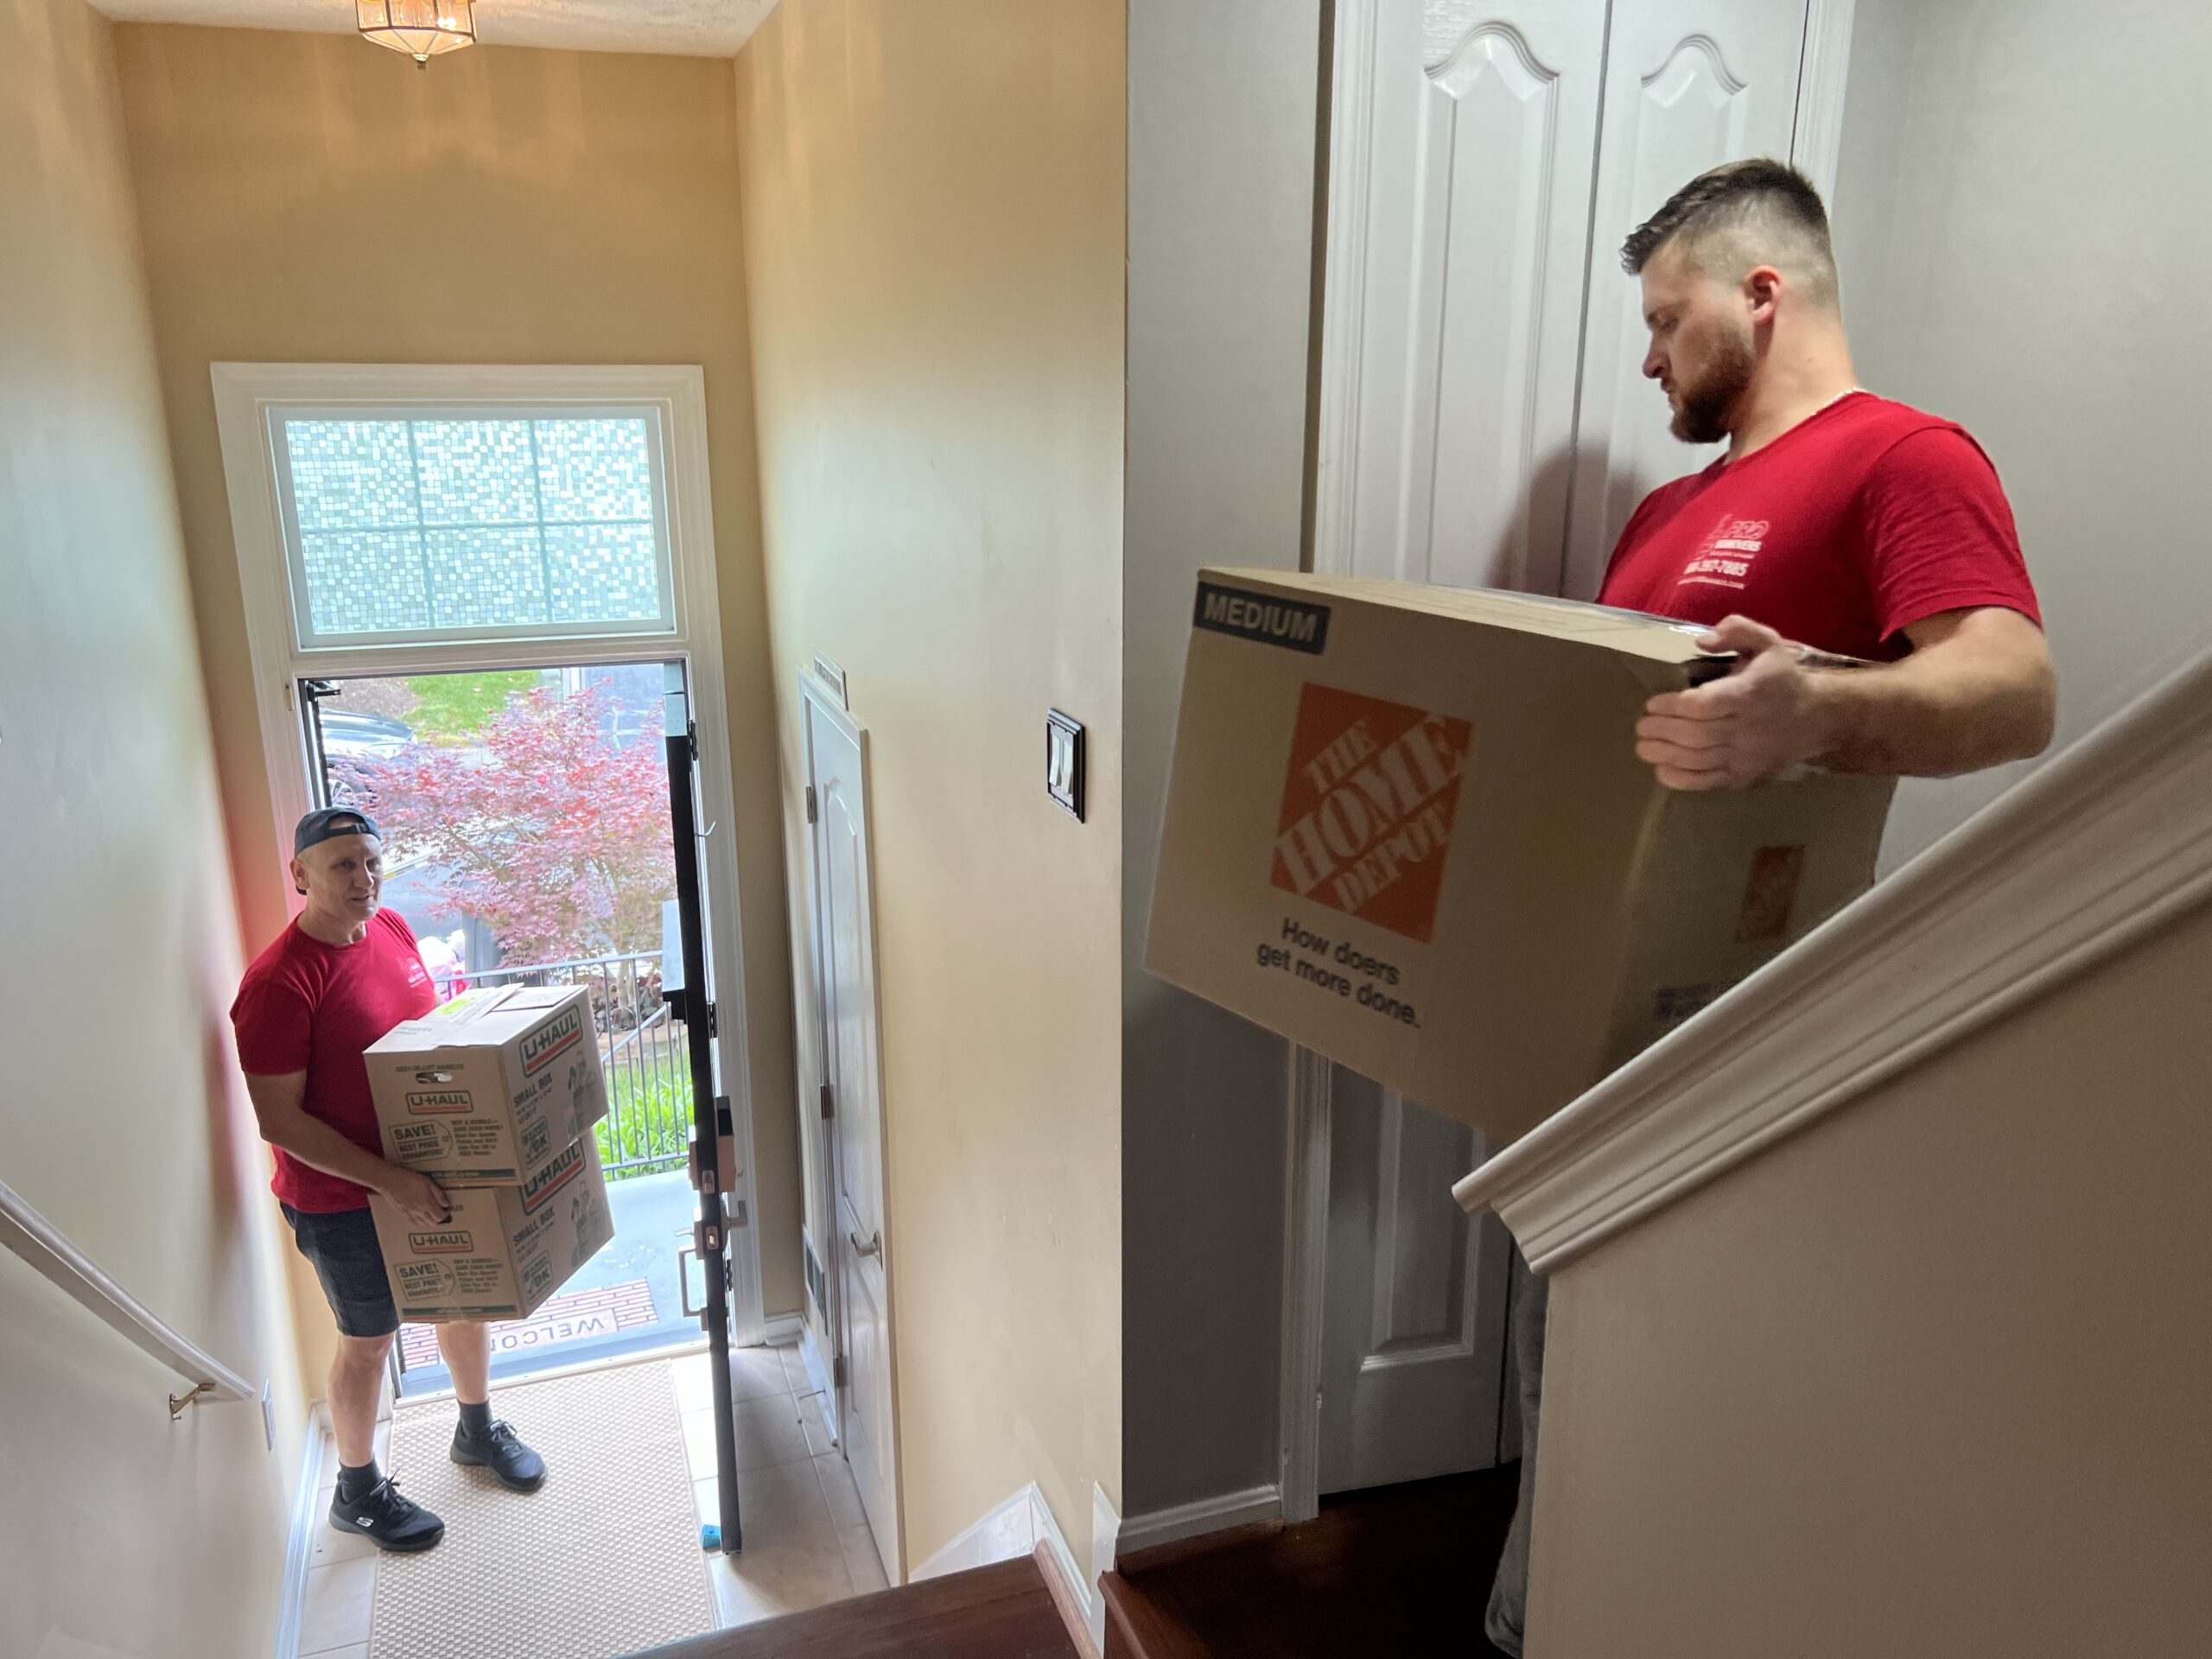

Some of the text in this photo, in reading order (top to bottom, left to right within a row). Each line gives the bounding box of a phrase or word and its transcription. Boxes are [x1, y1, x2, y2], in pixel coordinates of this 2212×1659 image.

[1204, 593, 1318, 643] MEDIUM
[1302, 717, 1380, 795] THE
[1277, 713, 1465, 899] HOME
[1332, 800, 1452, 913] DEPOT
[1281, 917, 1401, 985] How doers
[1257, 943, 1421, 1028] get more done.
[524, 1014, 577, 1060] U-HAUL
[410, 1094, 467, 1106] U-HAUL
[513, 1084, 537, 1108] SMALL
[539, 1071, 552, 1090] BOX
[394, 1123, 437, 1141] SAVE!
[524, 1145, 581, 1198] U-HAUL
[413, 1234, 468, 1246] U-HAUL
[513, 1220, 539, 1246] SMALL
[540, 1205, 555, 1225] BOX
[400, 1263, 439, 1278] SAVE!
